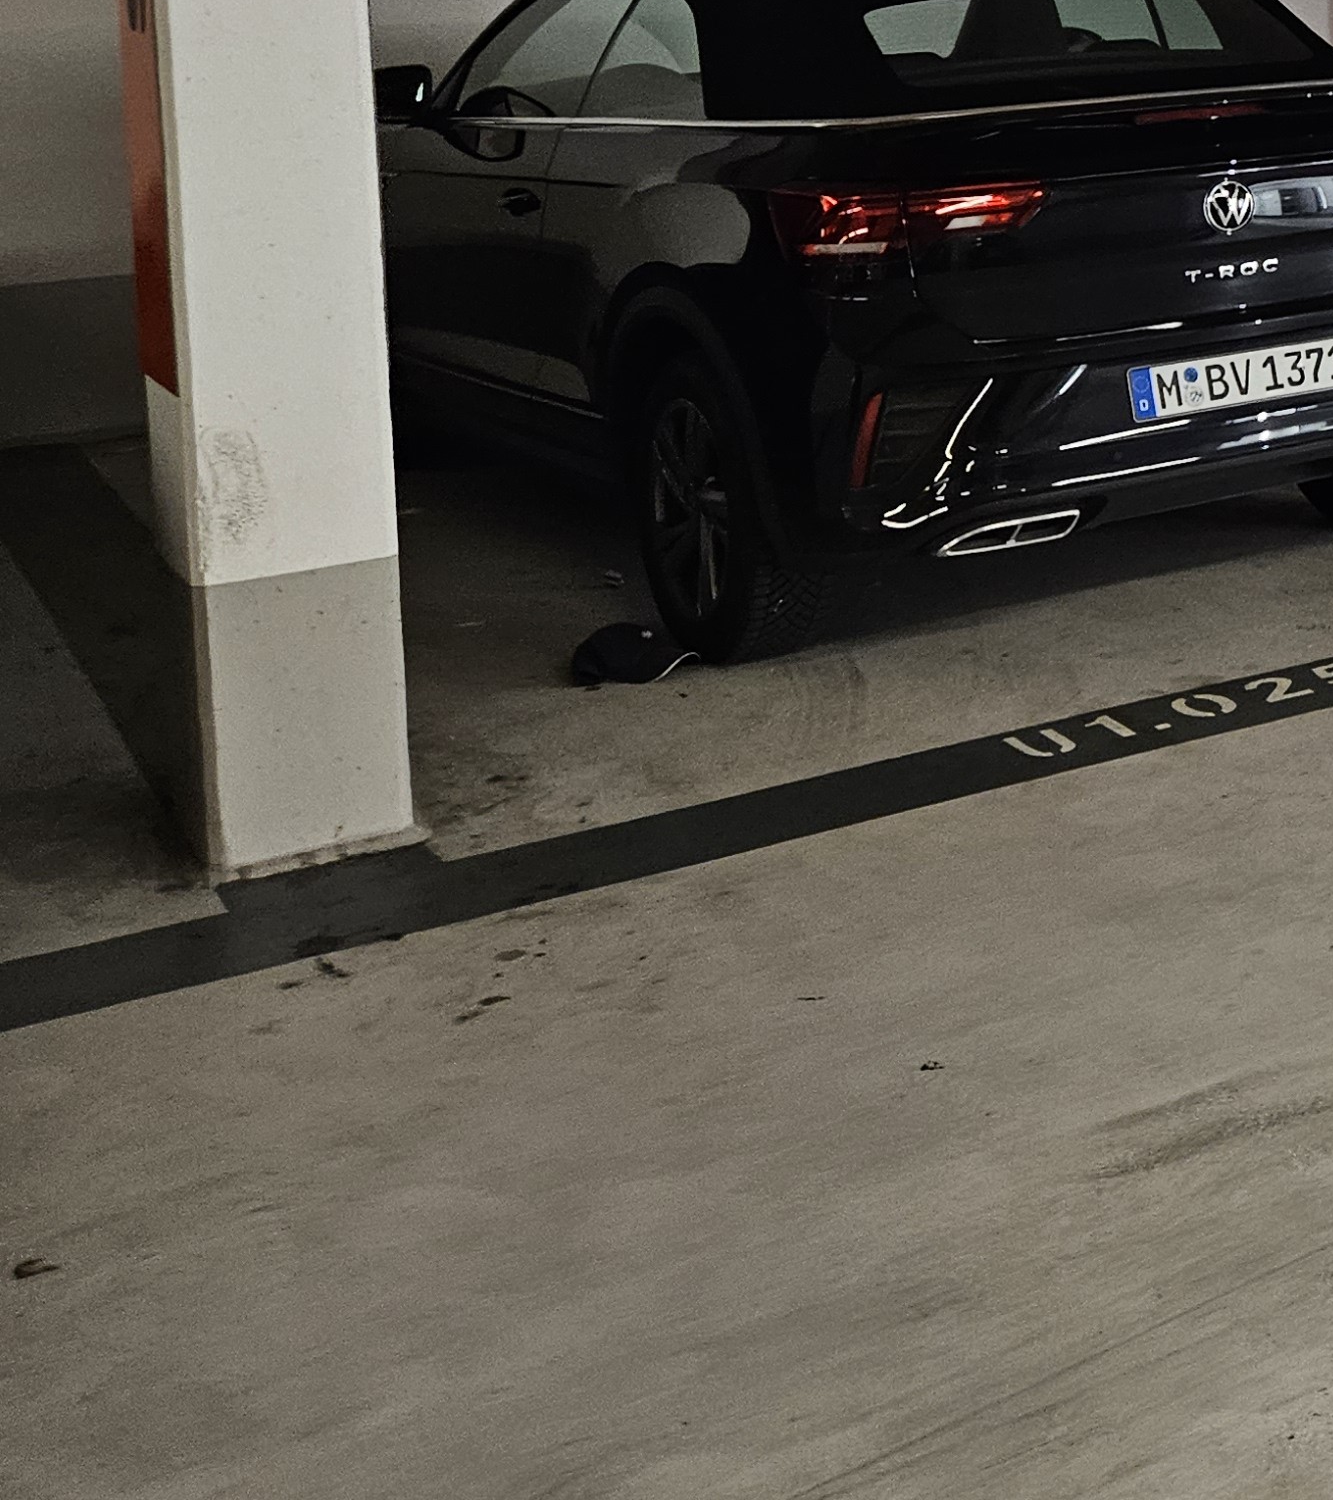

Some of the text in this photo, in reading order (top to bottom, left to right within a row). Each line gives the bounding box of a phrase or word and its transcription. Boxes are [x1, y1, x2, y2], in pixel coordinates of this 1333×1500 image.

[1185, 258, 1279, 283] T-ROC
[1156, 369, 1183, 410] M
[1205, 358, 1251, 401] BV
